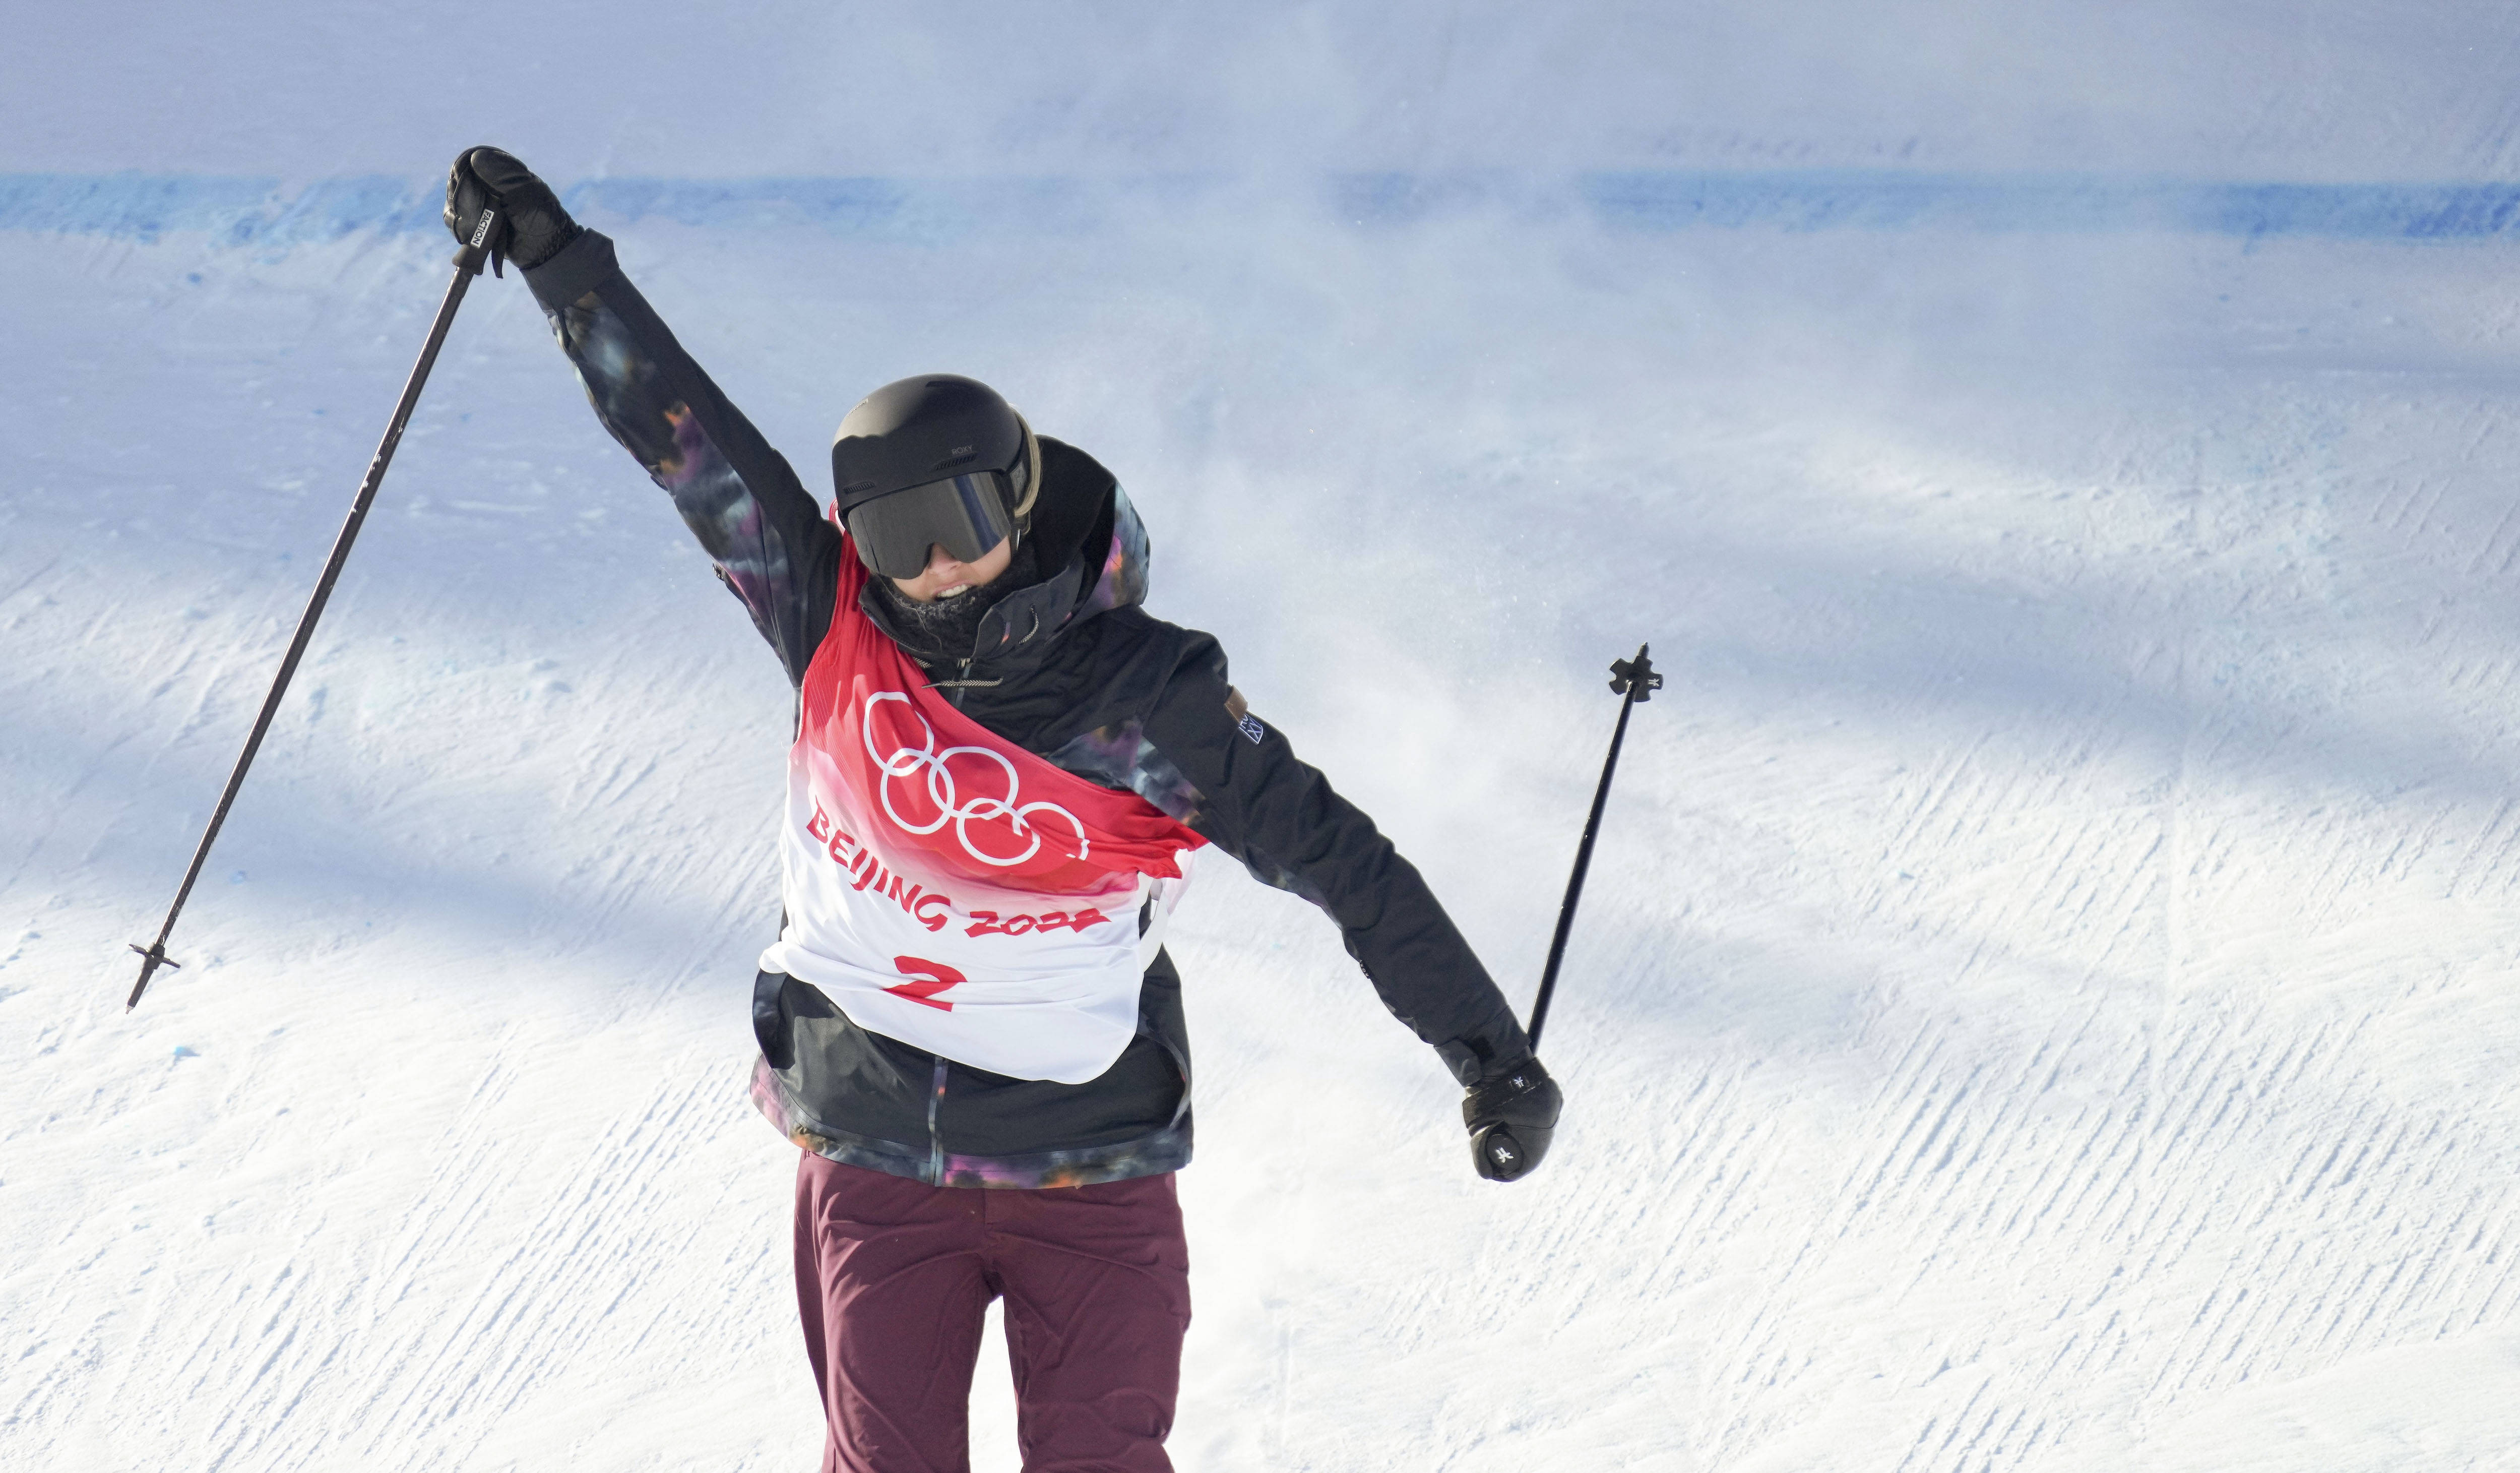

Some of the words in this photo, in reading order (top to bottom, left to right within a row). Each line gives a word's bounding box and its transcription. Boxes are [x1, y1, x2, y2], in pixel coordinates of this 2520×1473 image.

[473, 211, 492, 245] FACTION
[951, 445, 972, 455] ROXY
[806, 794, 952, 932] BEIJING
[964, 908, 1112, 938] 2022
[880, 955, 968, 1012] 2
